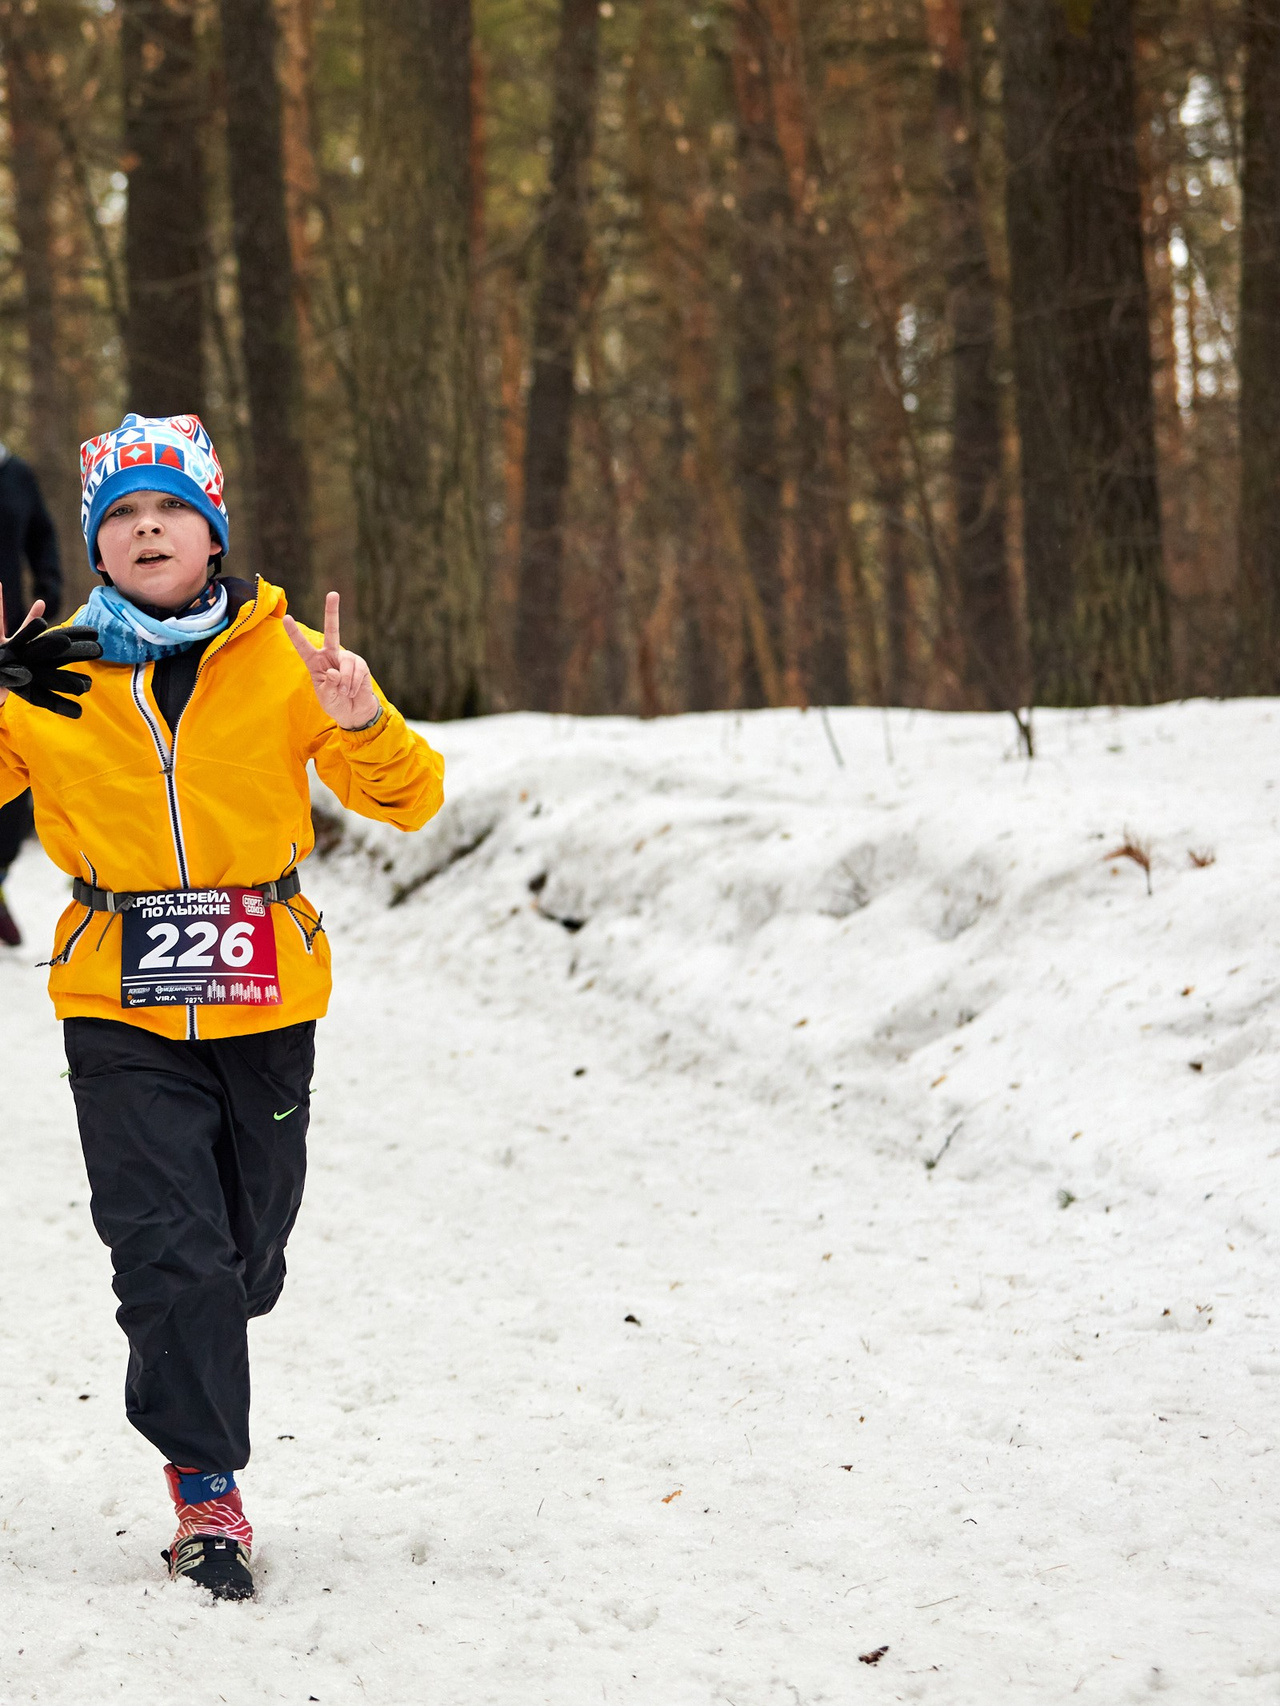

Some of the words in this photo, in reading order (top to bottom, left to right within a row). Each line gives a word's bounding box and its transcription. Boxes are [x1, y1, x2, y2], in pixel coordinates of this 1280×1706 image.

[176, 890, 231, 904] ТРЕЙЛ
[142, 906, 164, 919] ПО
[166, 904, 231, 917] ЛЫЖНЕ
[138, 921, 256, 970] 226
